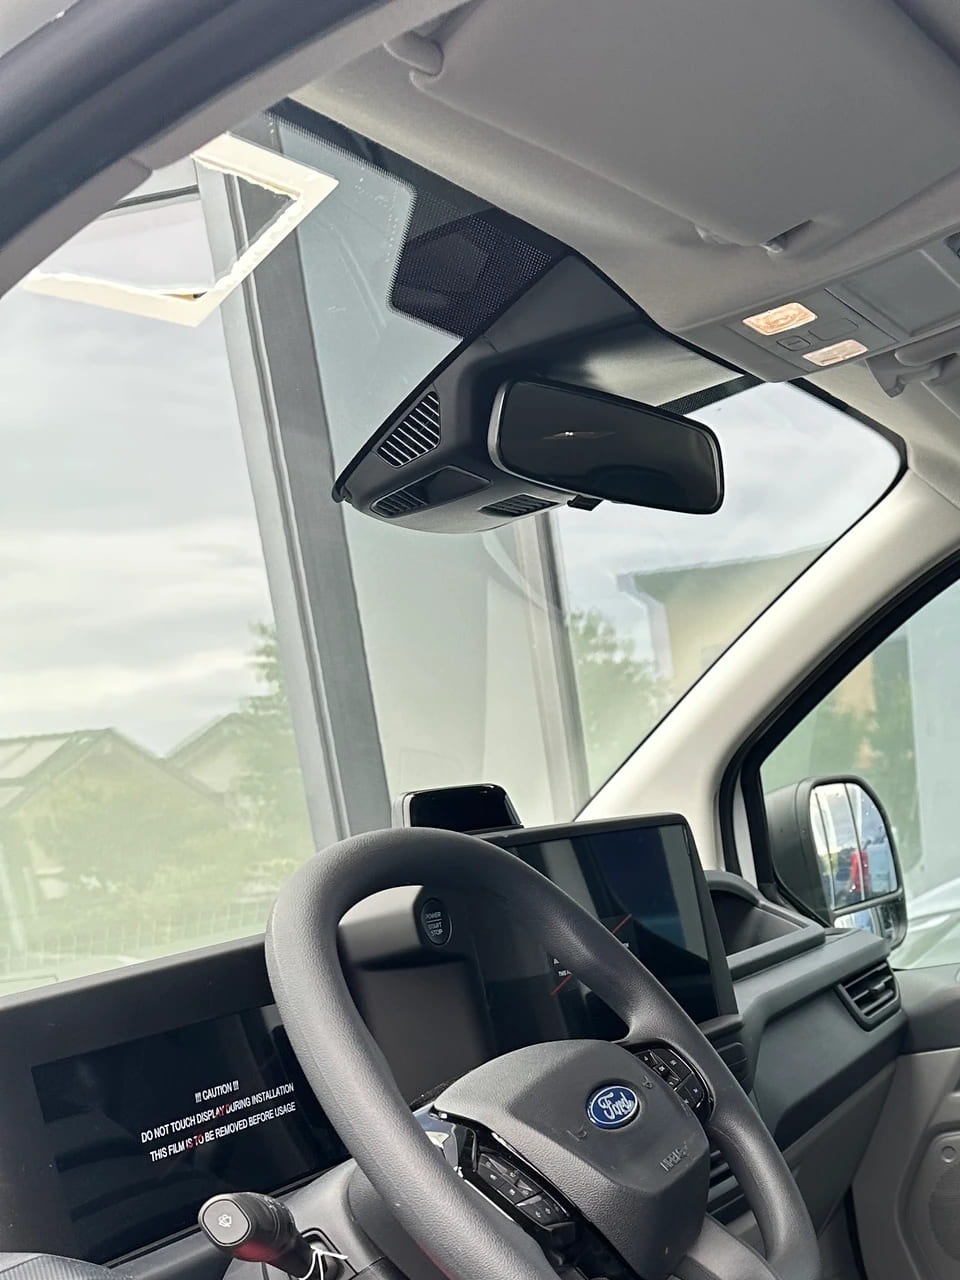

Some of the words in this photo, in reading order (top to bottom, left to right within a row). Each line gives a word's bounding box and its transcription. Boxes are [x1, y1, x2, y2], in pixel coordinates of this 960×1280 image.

[141, 1129, 154, 1143] DO
[153, 1124, 169, 1139] NOT
[170, 1115, 196, 1133] TOUCH
[196, 1105, 225, 1124] DISPLAY
[225, 1097, 251, 1114] DURING
[251, 1083, 295, 1105] INSTALLATION
[202, 1082, 232, 1100] CAUTION
[597, 1090, 634, 1120] Ford
[149, 1147, 168, 1162] THIS
[167, 1140, 186, 1156] FILM
[185, 1138, 194, 1149] IS
[193, 1133, 204, 1146] TO
[204, 1130, 215, 1142] BE
[215, 1119, 248, 1138] REMOVED
[248, 1109, 274, 1126] BEFORE
[274, 1102, 296, 1117] USAGE
